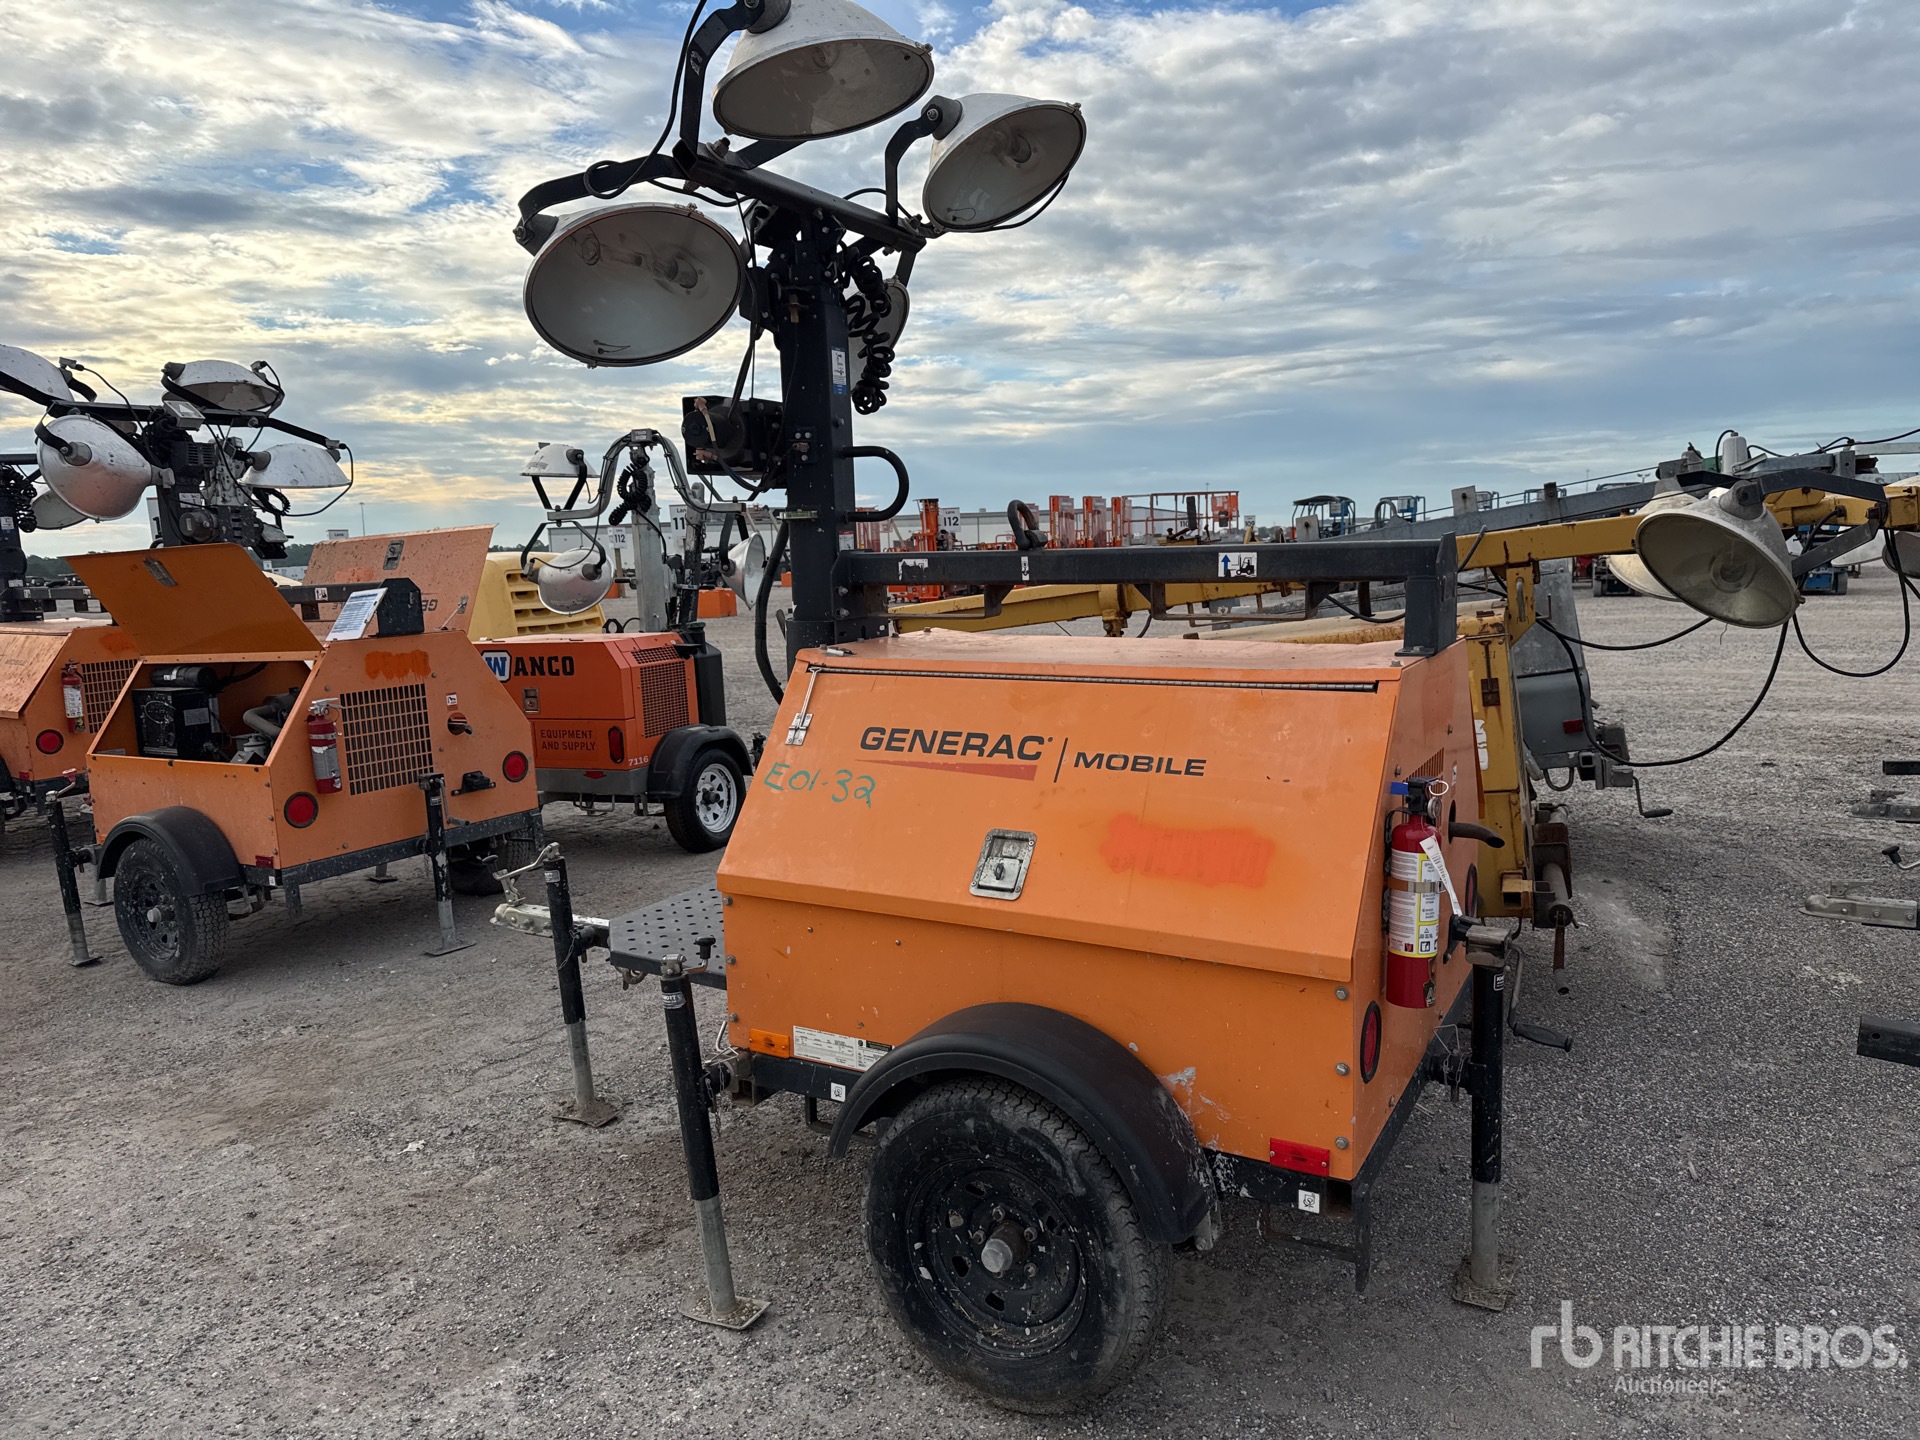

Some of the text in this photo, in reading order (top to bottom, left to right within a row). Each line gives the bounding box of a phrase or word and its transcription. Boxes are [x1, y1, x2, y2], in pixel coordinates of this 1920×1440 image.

[944, 516, 959, 526] 112
[614, 534, 626, 542] 112
[540, 729, 593, 739] EQUIPMENT
[541, 740, 596, 751] AND SUPPLY
[860, 726, 1207, 777] GENERAC MOBILE
[628, 755, 650, 766] 7116
